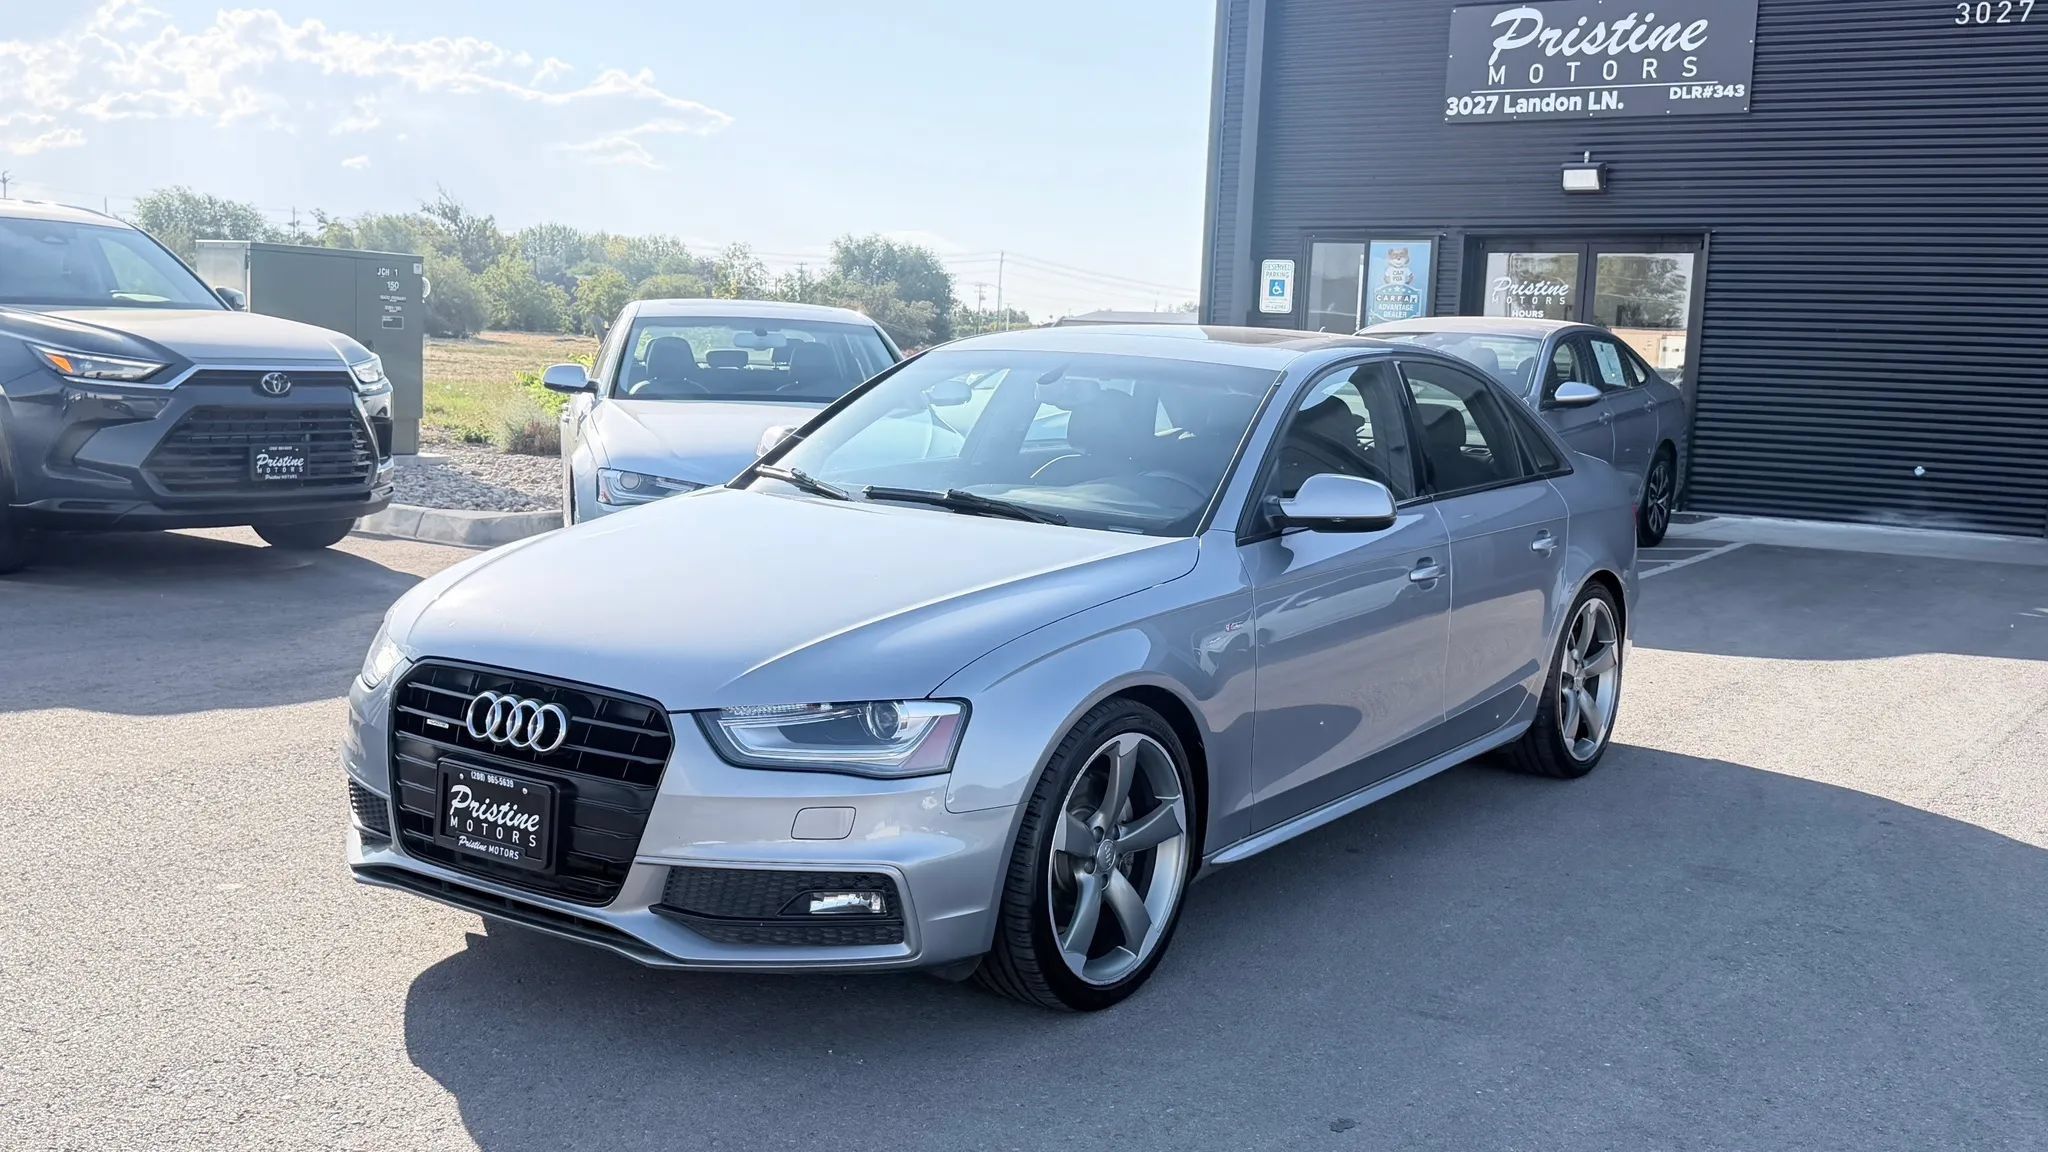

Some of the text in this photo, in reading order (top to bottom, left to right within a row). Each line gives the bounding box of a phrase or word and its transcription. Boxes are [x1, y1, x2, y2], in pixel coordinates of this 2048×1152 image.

[1955, 0, 2035, 25] 3027
[1488, 7, 1708, 65] Pristine
[1488, 56, 1698, 86] MOTORS
[1669, 84, 1745, 101] DLR#343
[1446, 90, 1624, 116] 3027 Landon LN.
[1492, 277, 1569, 297] Pristine
[1376, 295, 1418, 303] CARFAX
[1379, 303, 1414, 311] ADVANTAGE
[1491, 296, 1566, 305] MOTORS
[1511, 310, 1544, 318] HOURS
[256, 453, 305, 468] Pristine
[257, 466, 304, 474] MOTORS
[450, 784, 539, 832] Pristine
[450, 815, 537, 847] MOTORS
[458, 836, 519, 860] Pristine MOTORS
